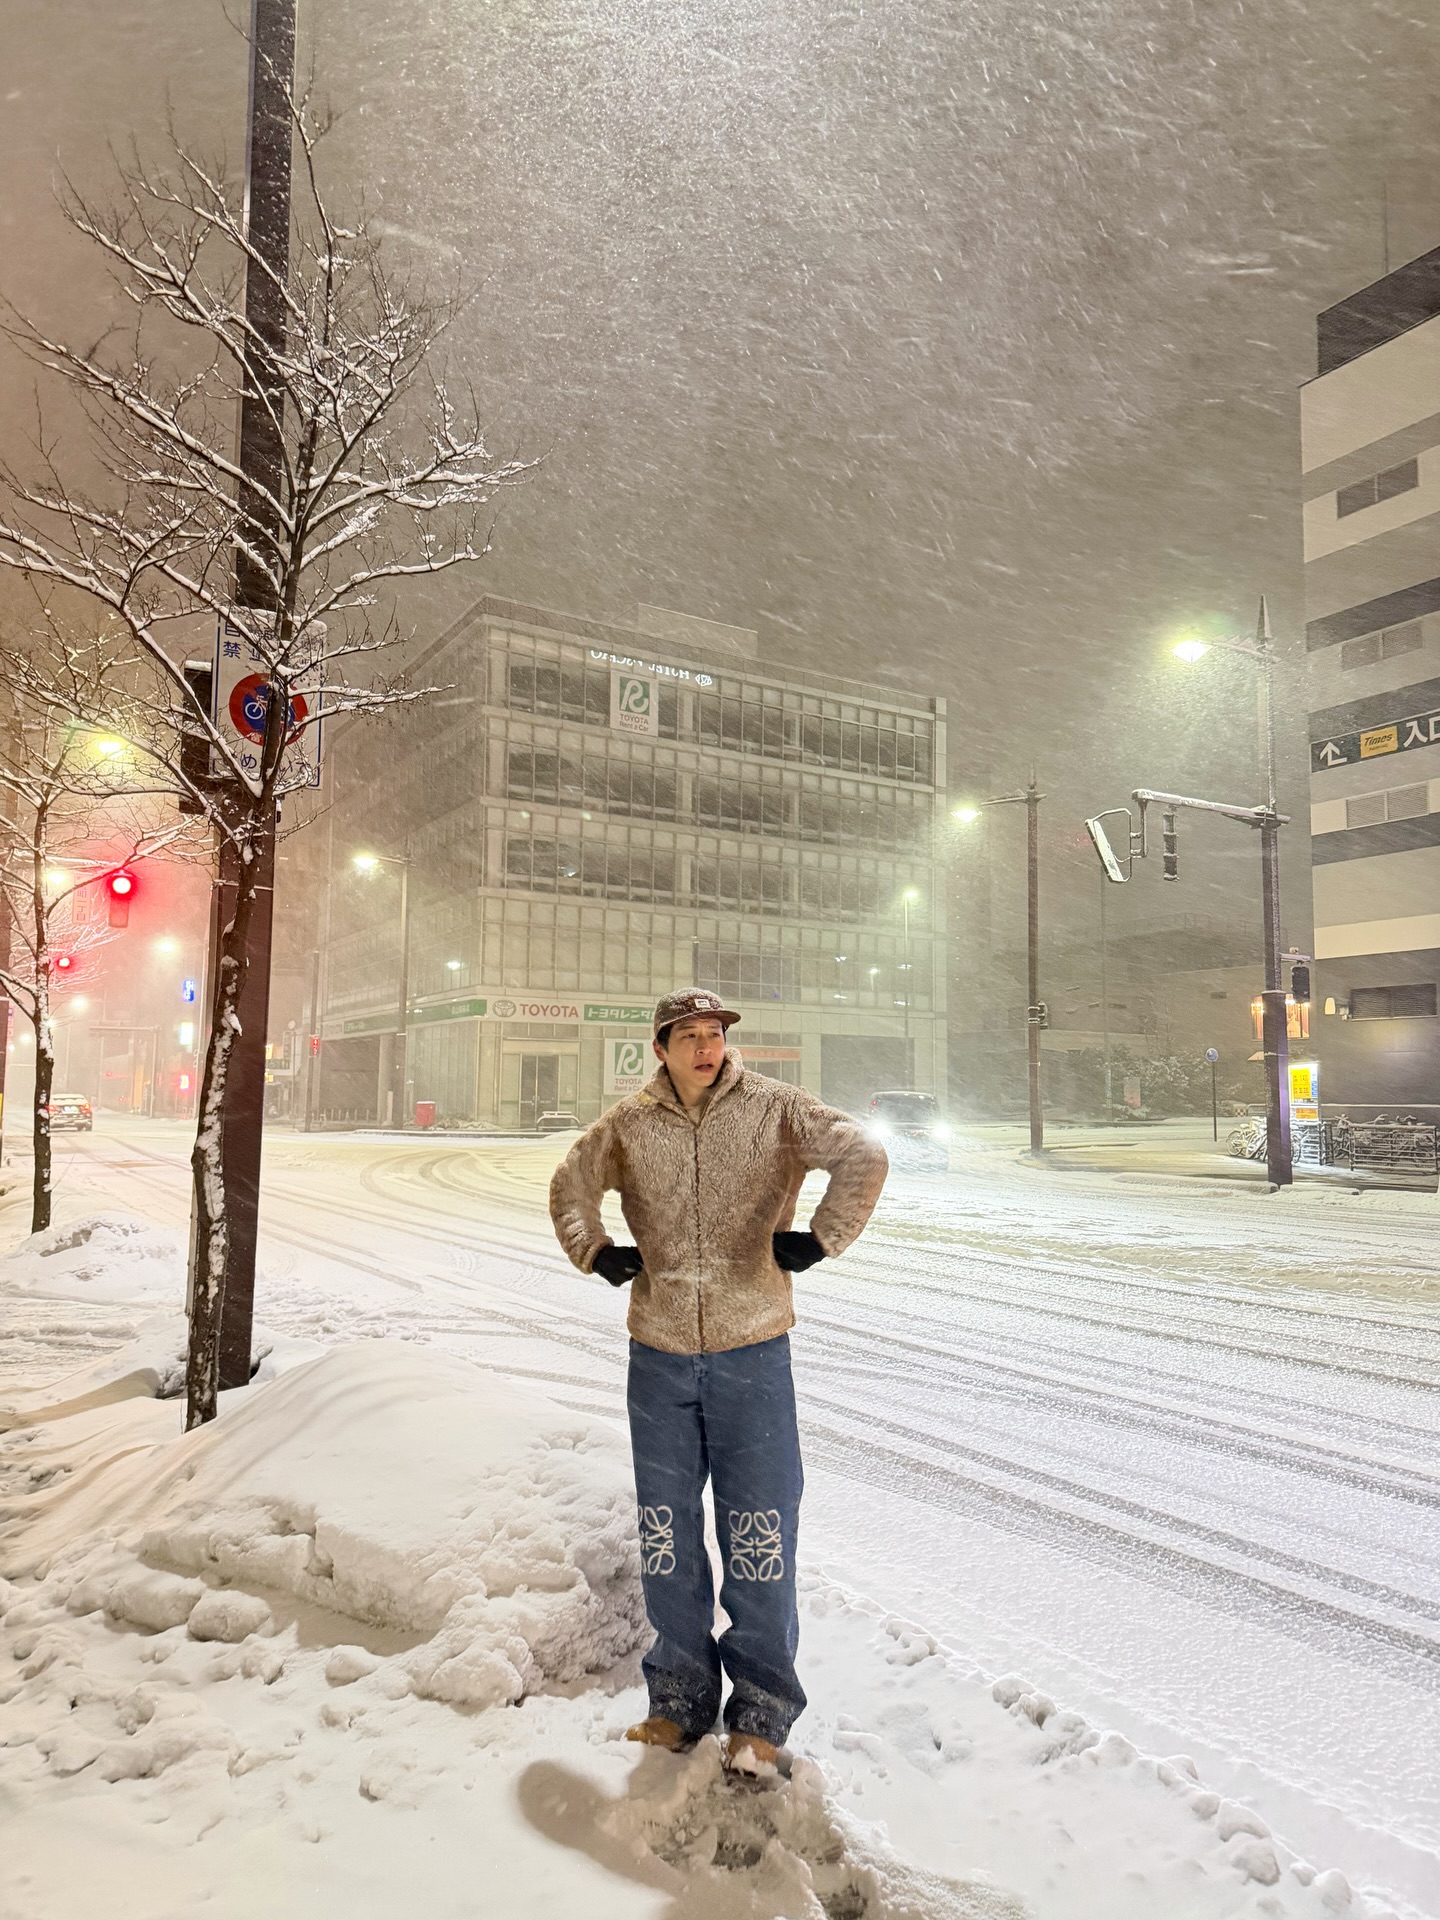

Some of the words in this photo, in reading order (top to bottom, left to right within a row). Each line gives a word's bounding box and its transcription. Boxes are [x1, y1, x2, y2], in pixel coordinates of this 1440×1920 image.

[620, 713, 649, 725] TOYOTA
[619, 721, 633, 729] Rent
[639, 724, 649, 732] Car
[1402, 718, 1440, 748] 入口
[1364, 733, 1393, 746] Times
[520, 1003, 579, 1018] TOYOTA
[588, 1007, 655, 1020] トヨタレンタ
